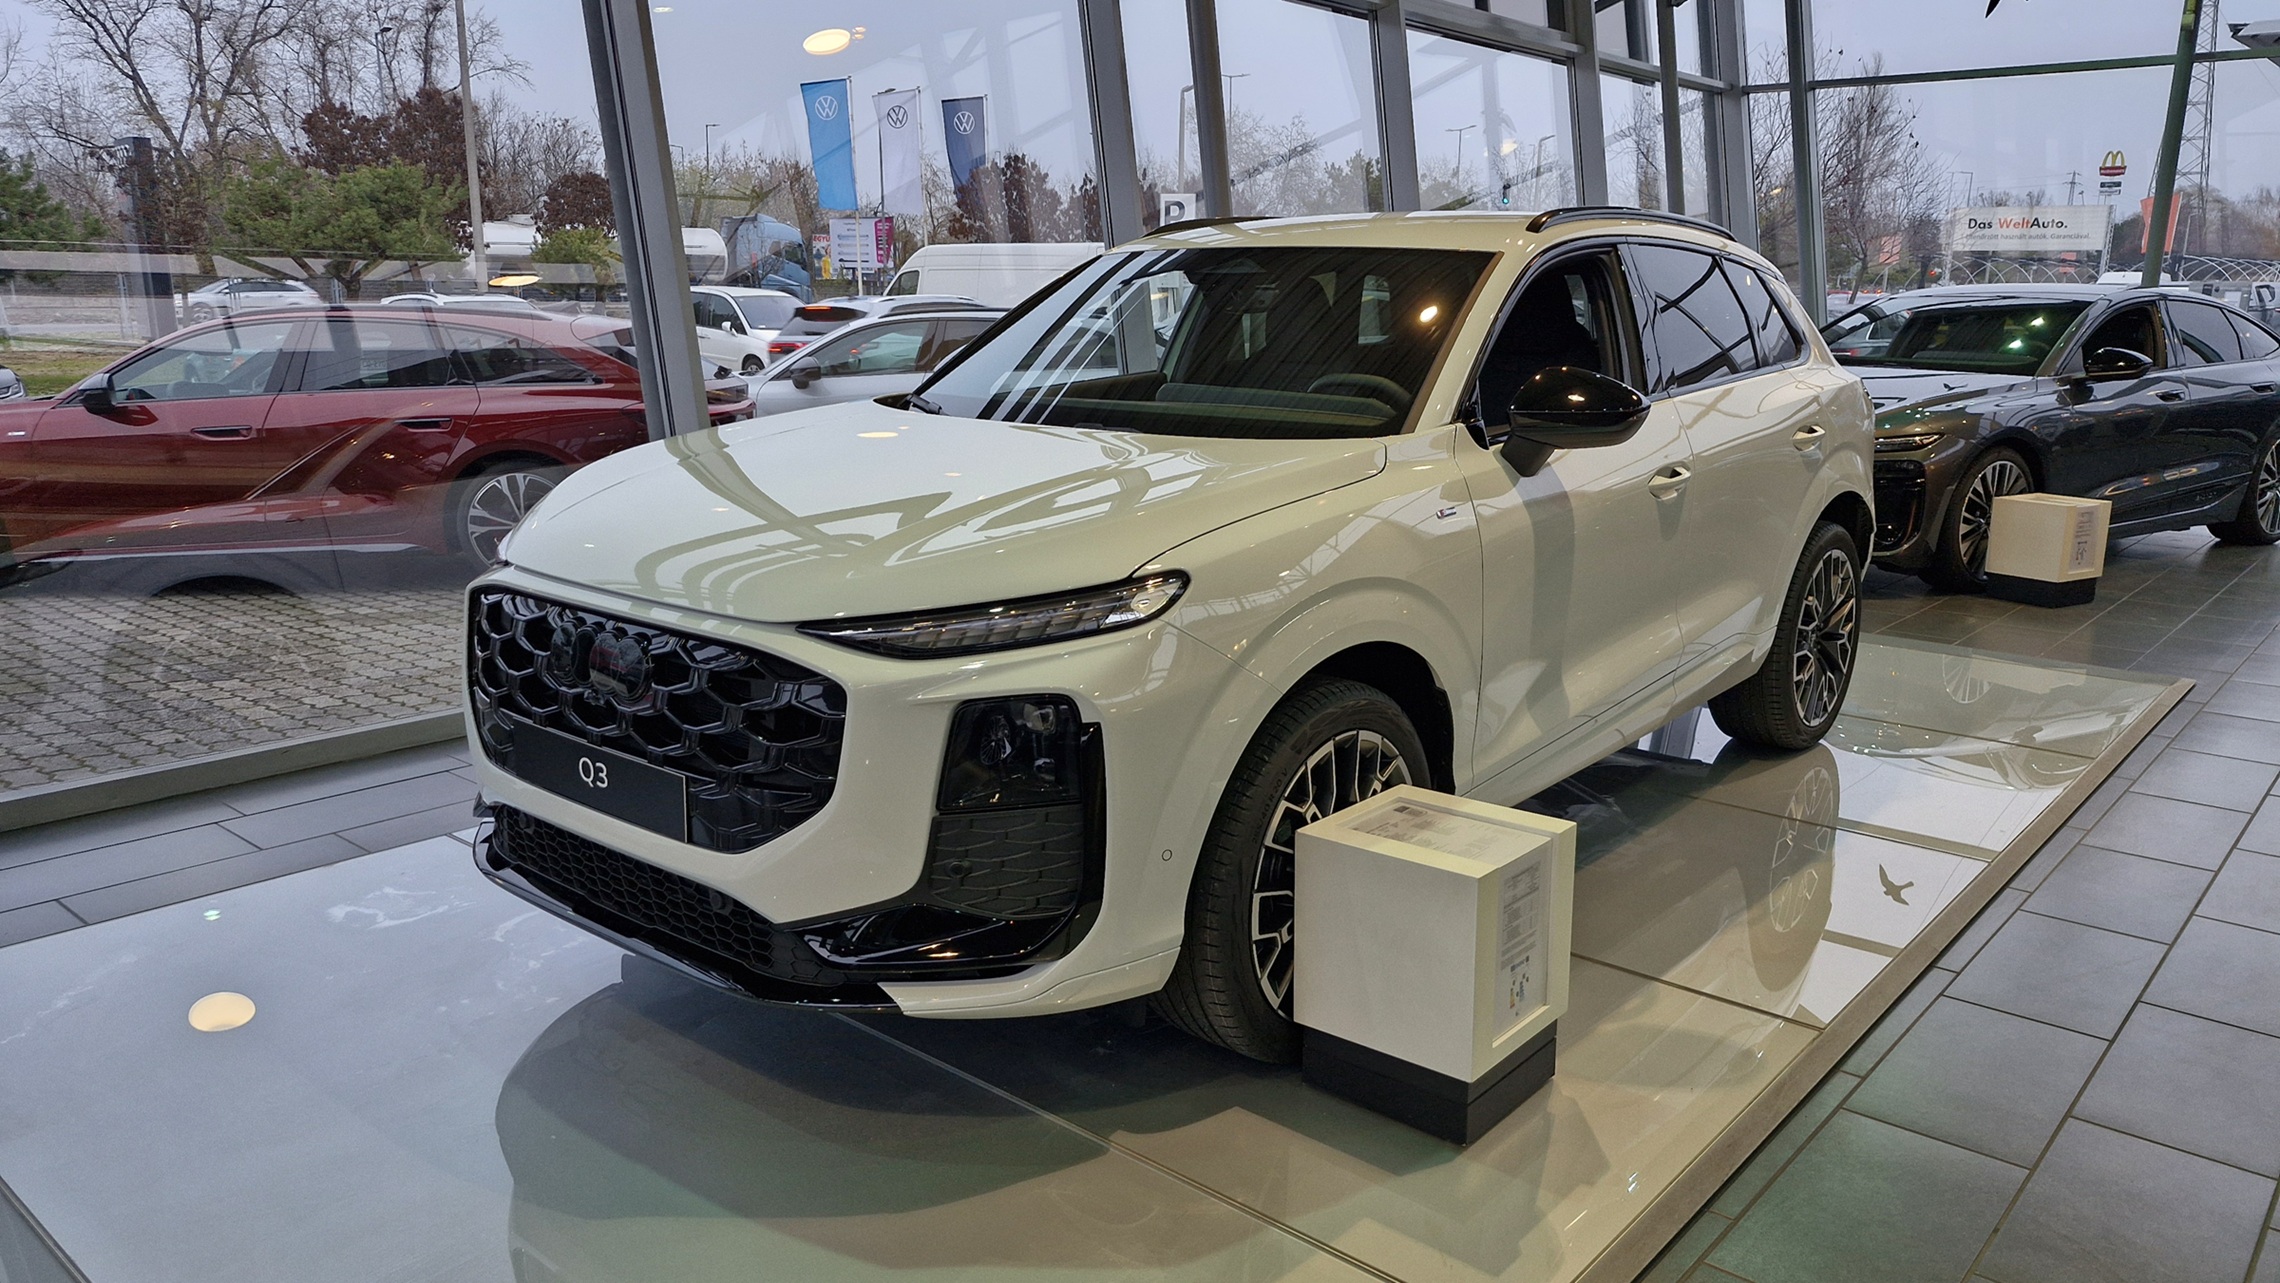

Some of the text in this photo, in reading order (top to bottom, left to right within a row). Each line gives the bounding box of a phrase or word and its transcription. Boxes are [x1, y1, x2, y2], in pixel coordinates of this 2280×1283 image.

[1165, 200, 1186, 225] P
[1968, 217, 2068, 230] Das WeltAuto.
[578, 756, 609, 788] Q3
